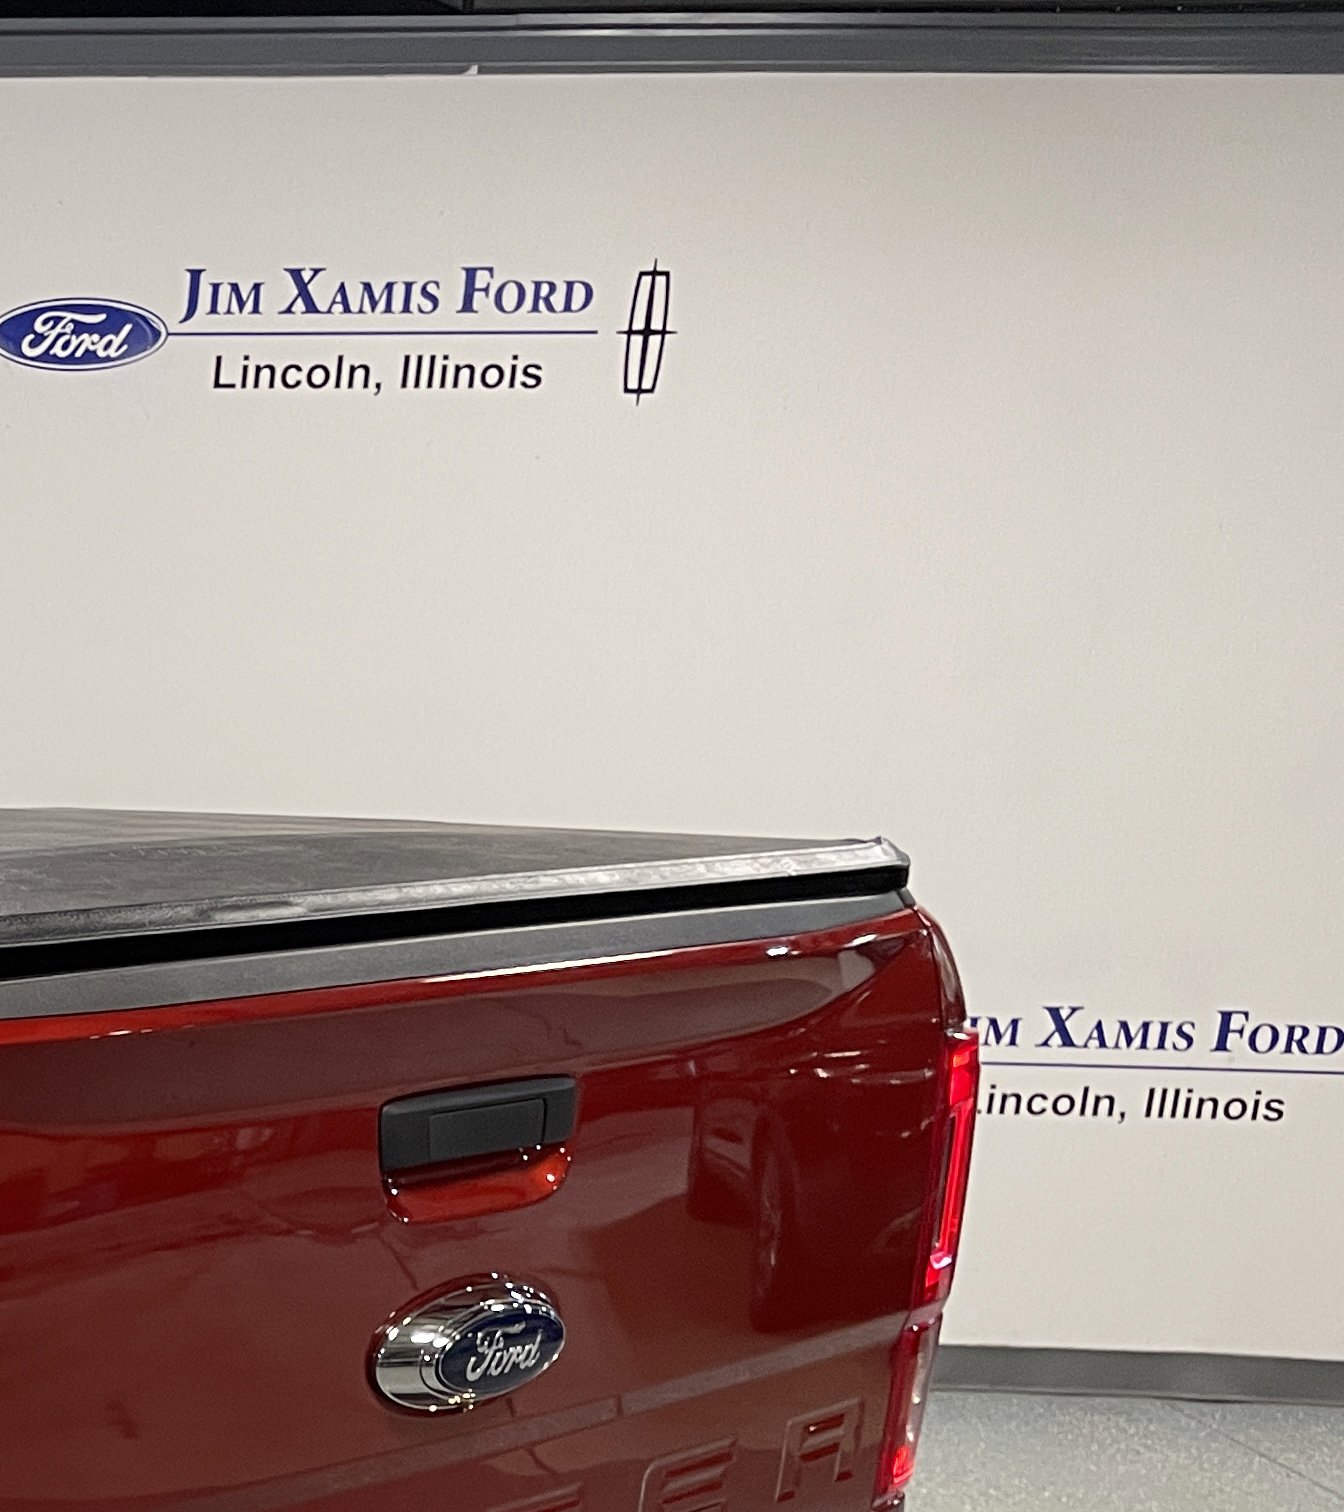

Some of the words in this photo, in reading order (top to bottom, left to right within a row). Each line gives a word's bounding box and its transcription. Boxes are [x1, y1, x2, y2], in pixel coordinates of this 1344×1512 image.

[178, 267, 266, 324] JIM
[277, 267, 441, 315] XAMIS
[455, 266, 595, 314] FORD
[20, 309, 134, 358] Ford
[212, 354, 383, 396] Lincoln,
[400, 354, 543, 389] Illinois
[1034, 1005, 1196, 1052] XAMIS
[1209, 1010, 1344, 1056] FORD
[976, 1084, 1126, 1124] incoln,
[1144, 1087, 1285, 1122] Illinois
[466, 1320, 544, 1382] Ford
